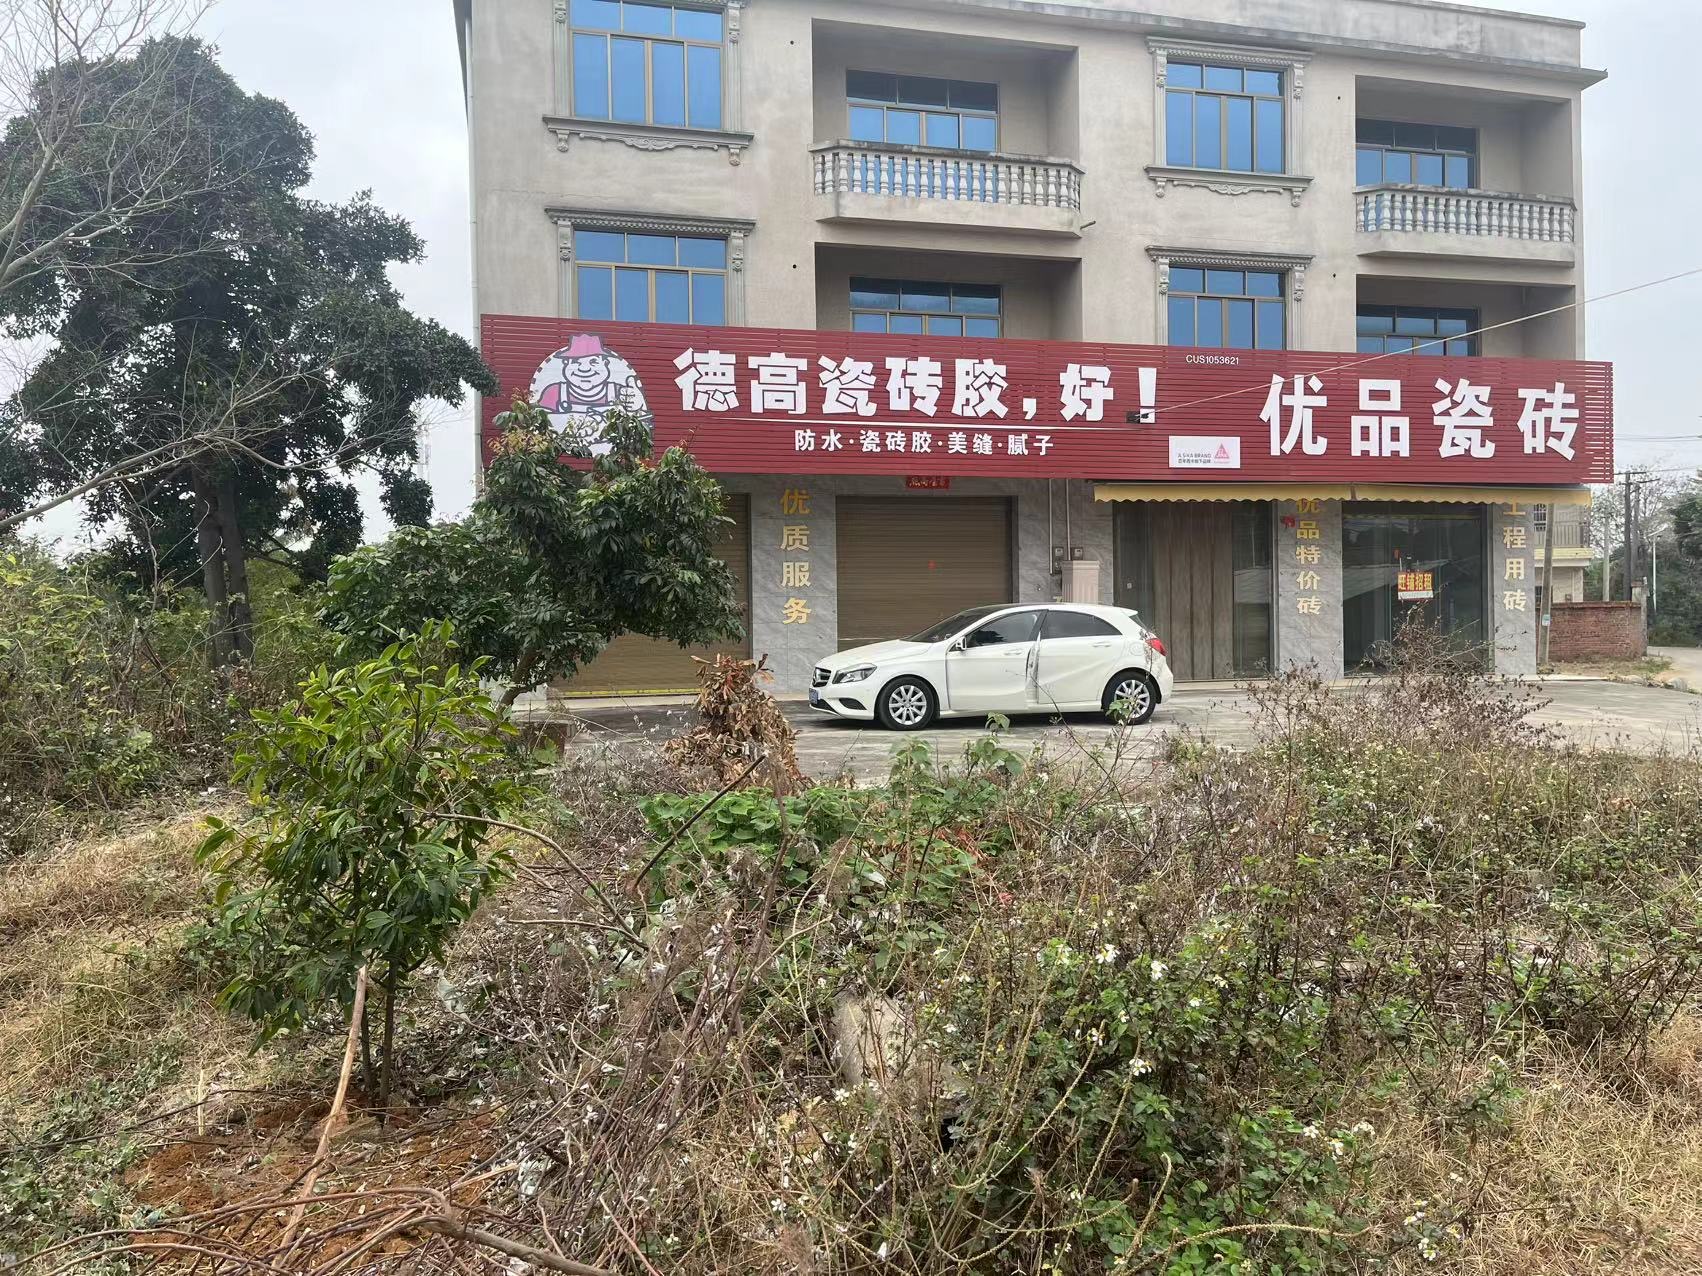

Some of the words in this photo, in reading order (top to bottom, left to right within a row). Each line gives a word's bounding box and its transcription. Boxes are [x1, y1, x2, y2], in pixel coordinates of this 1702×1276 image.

[1185, 354, 1239, 365] CUS1053621
[1259, 373, 1580, 462] 优品瓷砖
[780, 488, 812, 625] 优质服务
[1296, 499, 1322, 615] 优品特价砖
[1398, 572, 1432, 590] 旺铺招租
